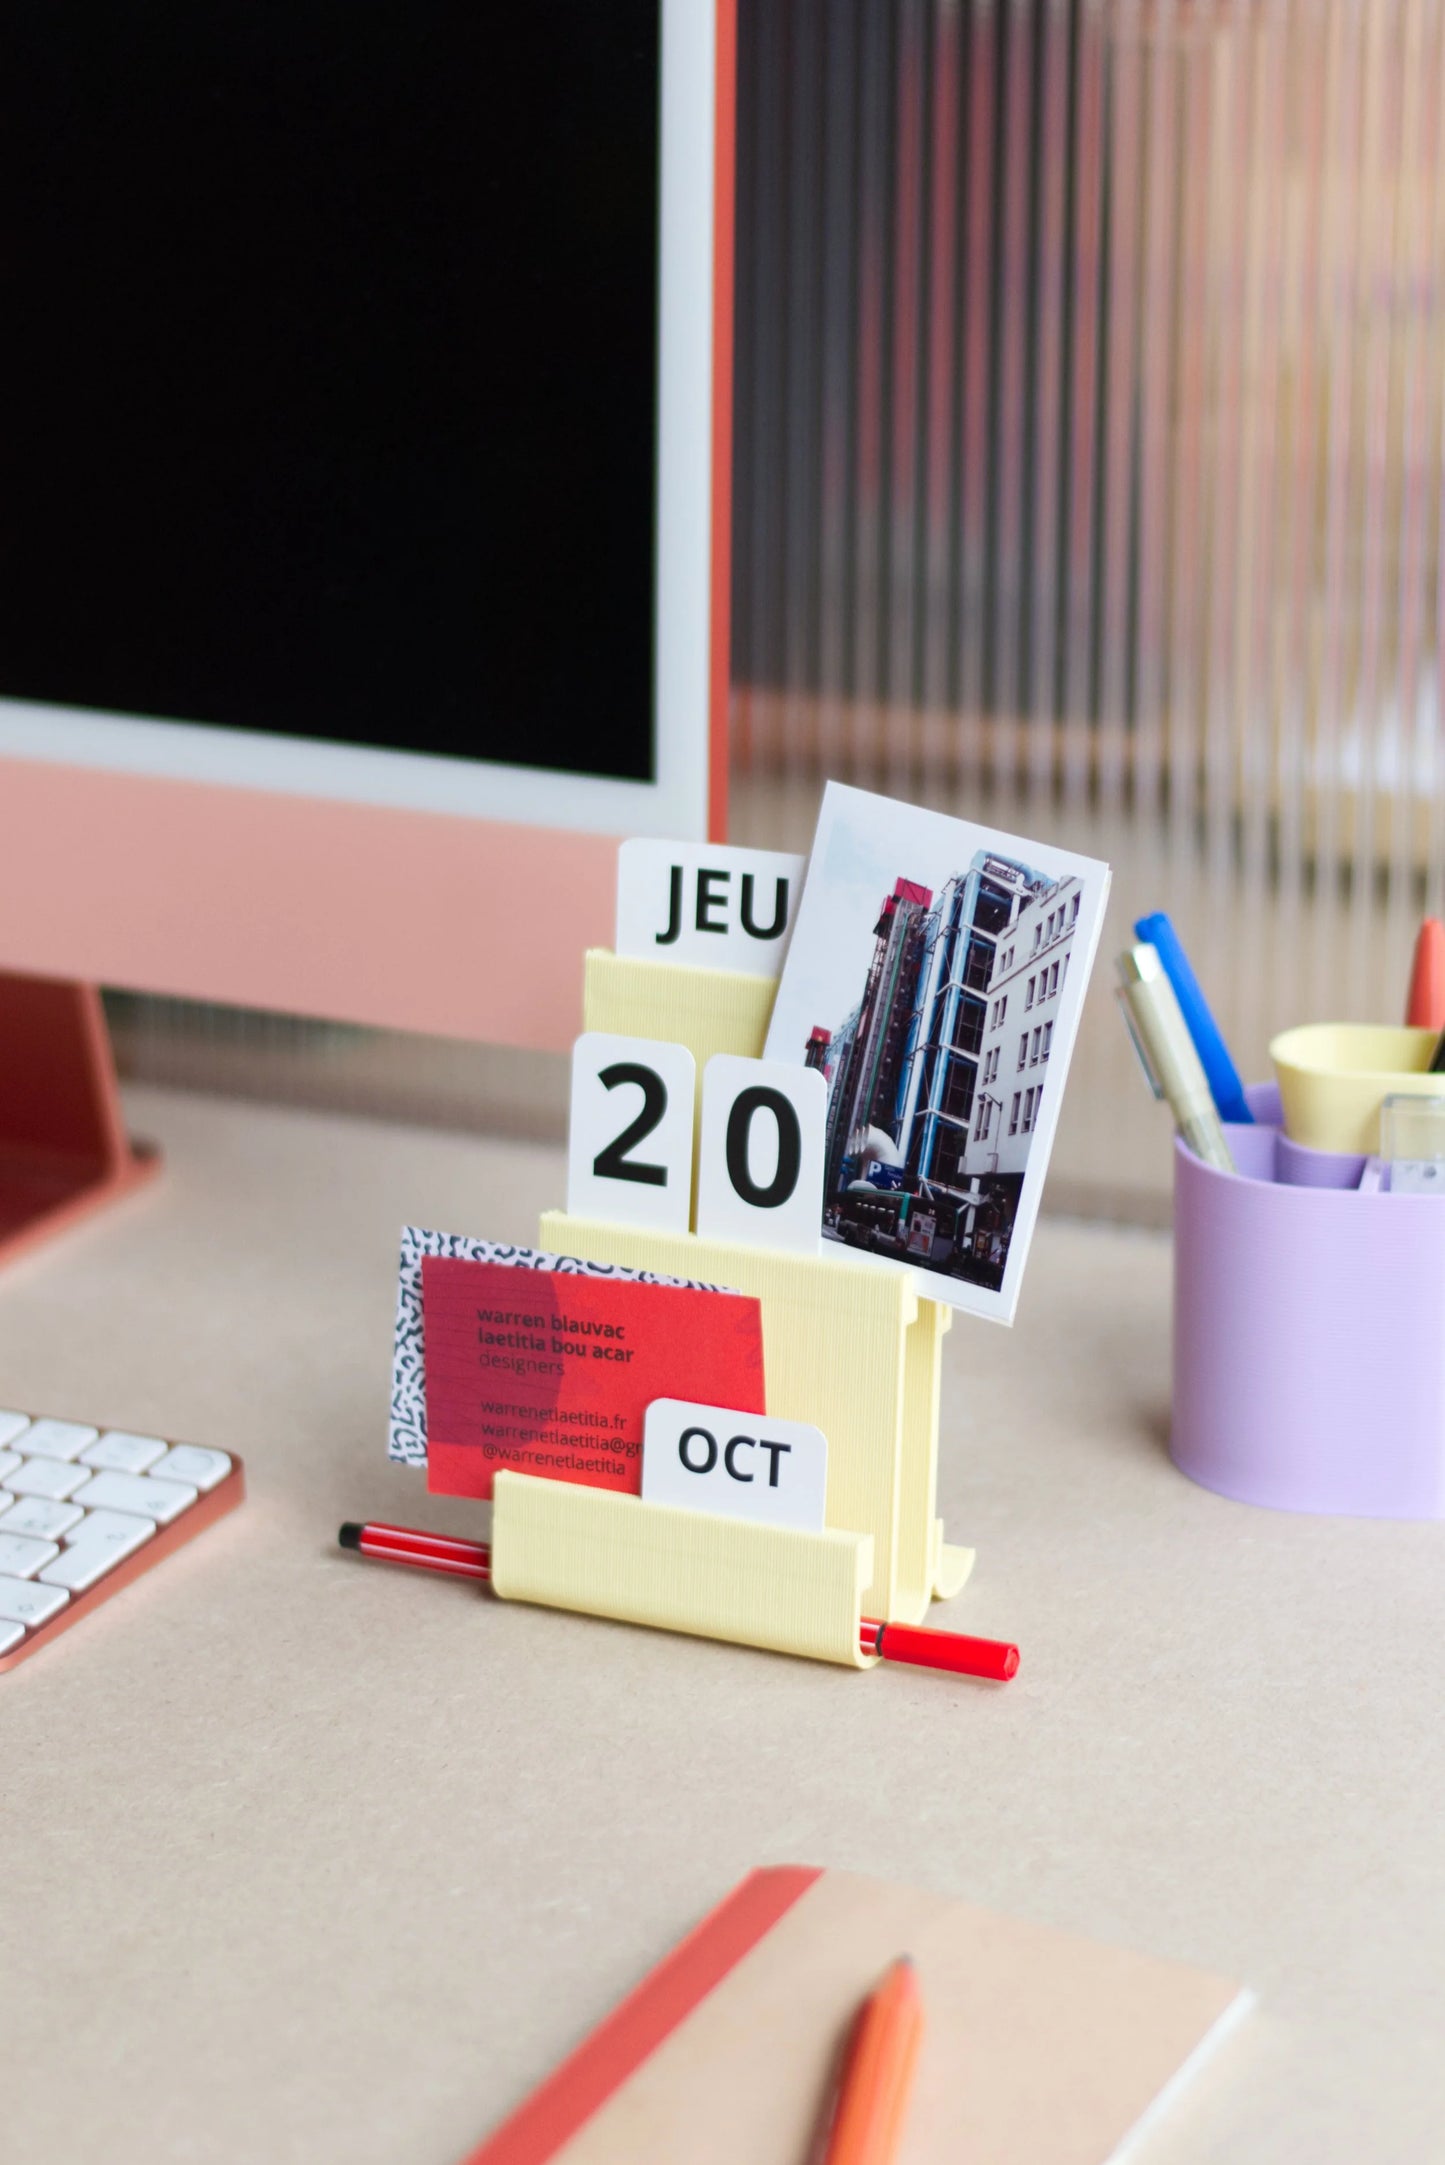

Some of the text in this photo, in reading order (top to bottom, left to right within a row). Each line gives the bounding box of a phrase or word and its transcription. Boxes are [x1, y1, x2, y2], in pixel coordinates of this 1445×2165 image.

[655, 865, 789, 945] JEU
[868, 1160, 882, 1177] P
[477, 1309, 625, 1339] warren blauvac
[478, 1328, 635, 1363] laetitia bou acar
[479, 1350, 565, 1377] designers
[481, 1400, 627, 1430] warrenetlaetitia.fr
[482, 1443, 626, 1475] @warrenetlaetitia
[678, 1425, 793, 1488] OCT
